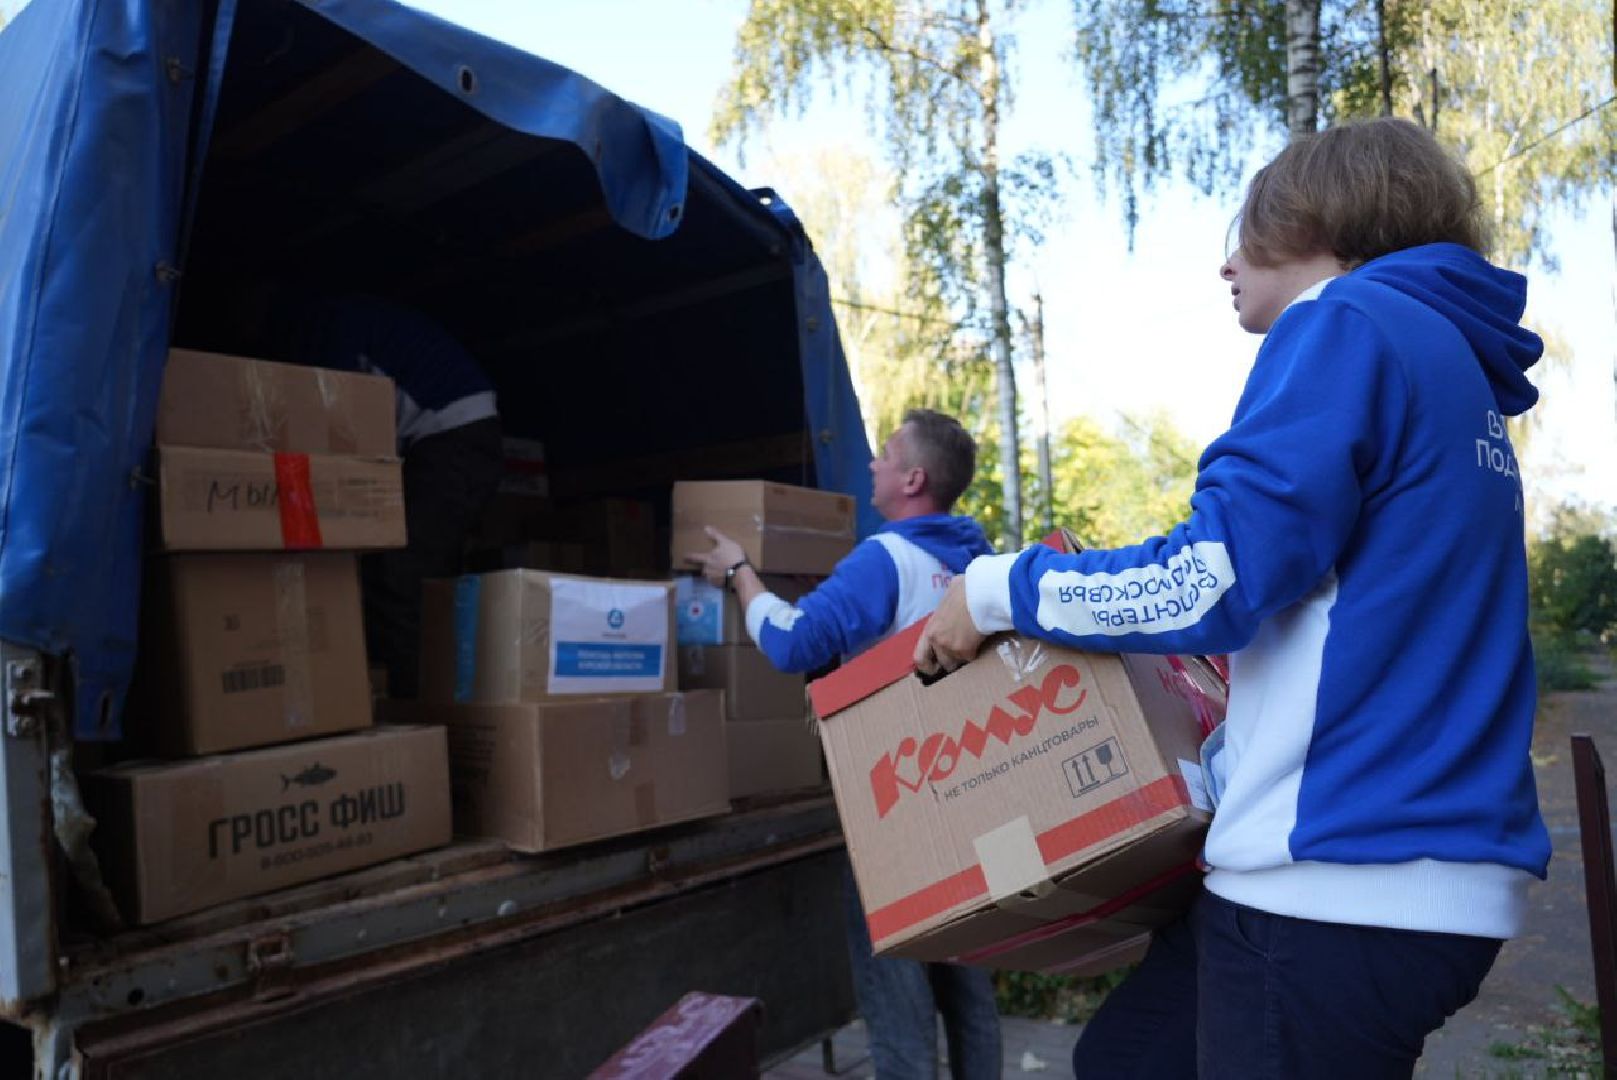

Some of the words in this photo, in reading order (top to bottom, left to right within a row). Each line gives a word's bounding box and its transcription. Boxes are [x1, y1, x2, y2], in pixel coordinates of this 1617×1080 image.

[944, 786, 961, 801] НЕ
[962, 761, 1009, 792] ТОЛЬКО
[1010, 715, 1100, 768] КАНЦТОВАРЫ
[208, 799, 320, 859] ГРОСС
[329, 782, 405, 829] ФИШ
